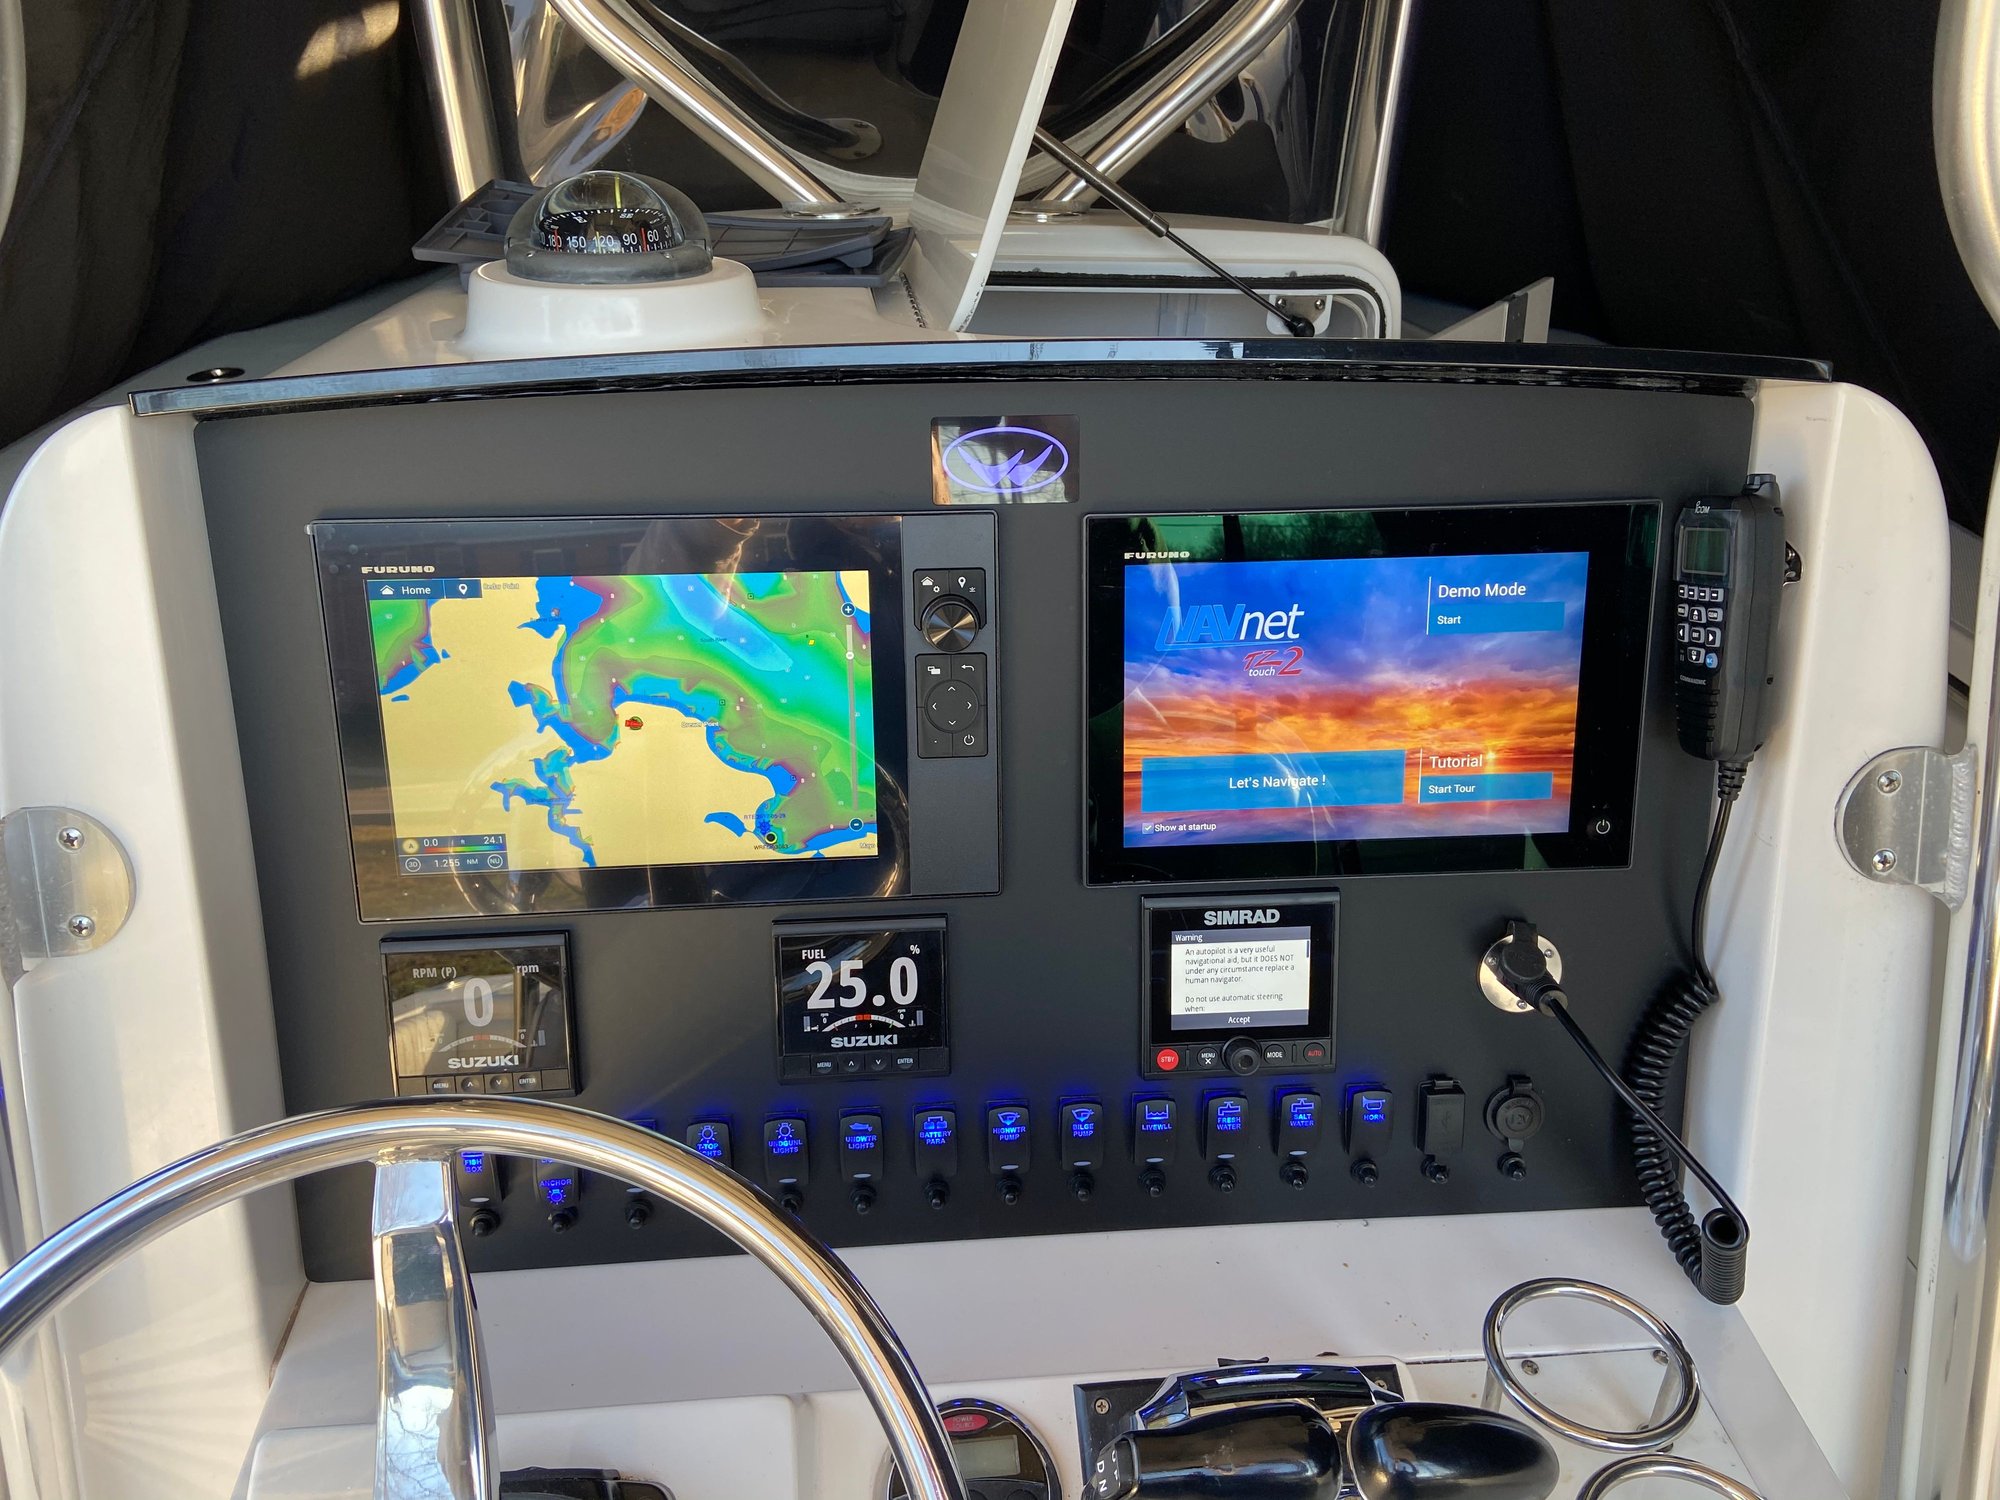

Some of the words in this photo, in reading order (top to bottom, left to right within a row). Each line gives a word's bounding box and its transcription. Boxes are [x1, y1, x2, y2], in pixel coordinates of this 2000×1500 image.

[566, 236, 586, 248] 150
[593, 235, 614, 248] 120
[623, 233, 637, 245] 90
[647, 229, 659, 242] 60
[1124, 551, 1190, 560] FURUNO
[361, 565, 436, 574] FURUNO
[401, 585, 431, 595] Home
[1438, 585, 1481, 598] Demo
[1485, 582, 1527, 596] Mode
[1437, 615, 1461, 625] Start
[1248, 666, 1275, 677] touch
[1429, 754, 1483, 769] Tutorial
[1229, 777, 1260, 789] Let's
[1263, 775, 1319, 790] Navigate
[1428, 785, 1452, 794] Start
[1454, 784, 1476, 793] Tour
[1154, 823, 1177, 832] Show
[1188, 823, 1217, 833] startup
[424, 838, 439, 847] 0.0
[483, 836, 503, 845] 24.1
[434, 858, 461, 868] 1.255
[1204, 909, 1280, 925] SIMRAD
[1175, 933, 1203, 942] Warning
[802, 949, 826, 960] FUEL
[910, 944, 920, 955] %
[1185, 948, 1195, 956] An
[1196, 947, 1226, 957] autopilot
[1239, 947, 1254, 955] very
[1255, 945, 1275, 953] useful
[1185, 957, 1225, 967] navigational
[1227, 956, 1239, 965] aid,
[1253, 955, 1258, 963] it
[1260, 955, 1278, 963] DOES
[1279, 954, 1294, 962] NOT
[412, 968, 437, 978] RPM
[441, 966, 457, 979] (P)
[516, 964, 539, 976] rpm
[1185, 967, 1205, 975] under
[1206, 967, 1218, 975] any
[1220, 965, 1263, 974] circumstance
[1265, 964, 1289, 973] replace
[805, 957, 918, 1010] 25.0
[1185, 976, 1209, 984] human
[1210, 976, 1243, 985] navigator.
[463, 977, 494, 1027] 0
[1197, 995, 1207, 1003] not
[1222, 993, 1255, 1002] automatic
[1257, 992, 1284, 1001] steering
[1227, 1016, 1251, 1025] Accept
[831, 1034, 898, 1048] SUZUKI
[1266, 1051, 1283, 1059] MODE
[1307, 1049, 1322, 1057] AUTO
[448, 1054, 519, 1069] SUZUKI
[519, 1077, 536, 1085] ENTER
[1072, 1123, 1094, 1131] BILGE
[1142, 1123, 1172, 1131] LIVEWLL
[1217, 1123, 1241, 1131] WATER
[920, 1130, 952, 1138] BATTERY
[1000, 1133, 1020, 1141] PUMP
[848, 1142, 875, 1150] LIGHTS
[464, 1158, 482, 1166] FISH
[466, 1165, 483, 1173] BOX
[539, 1178, 573, 1187] ANCHOR
